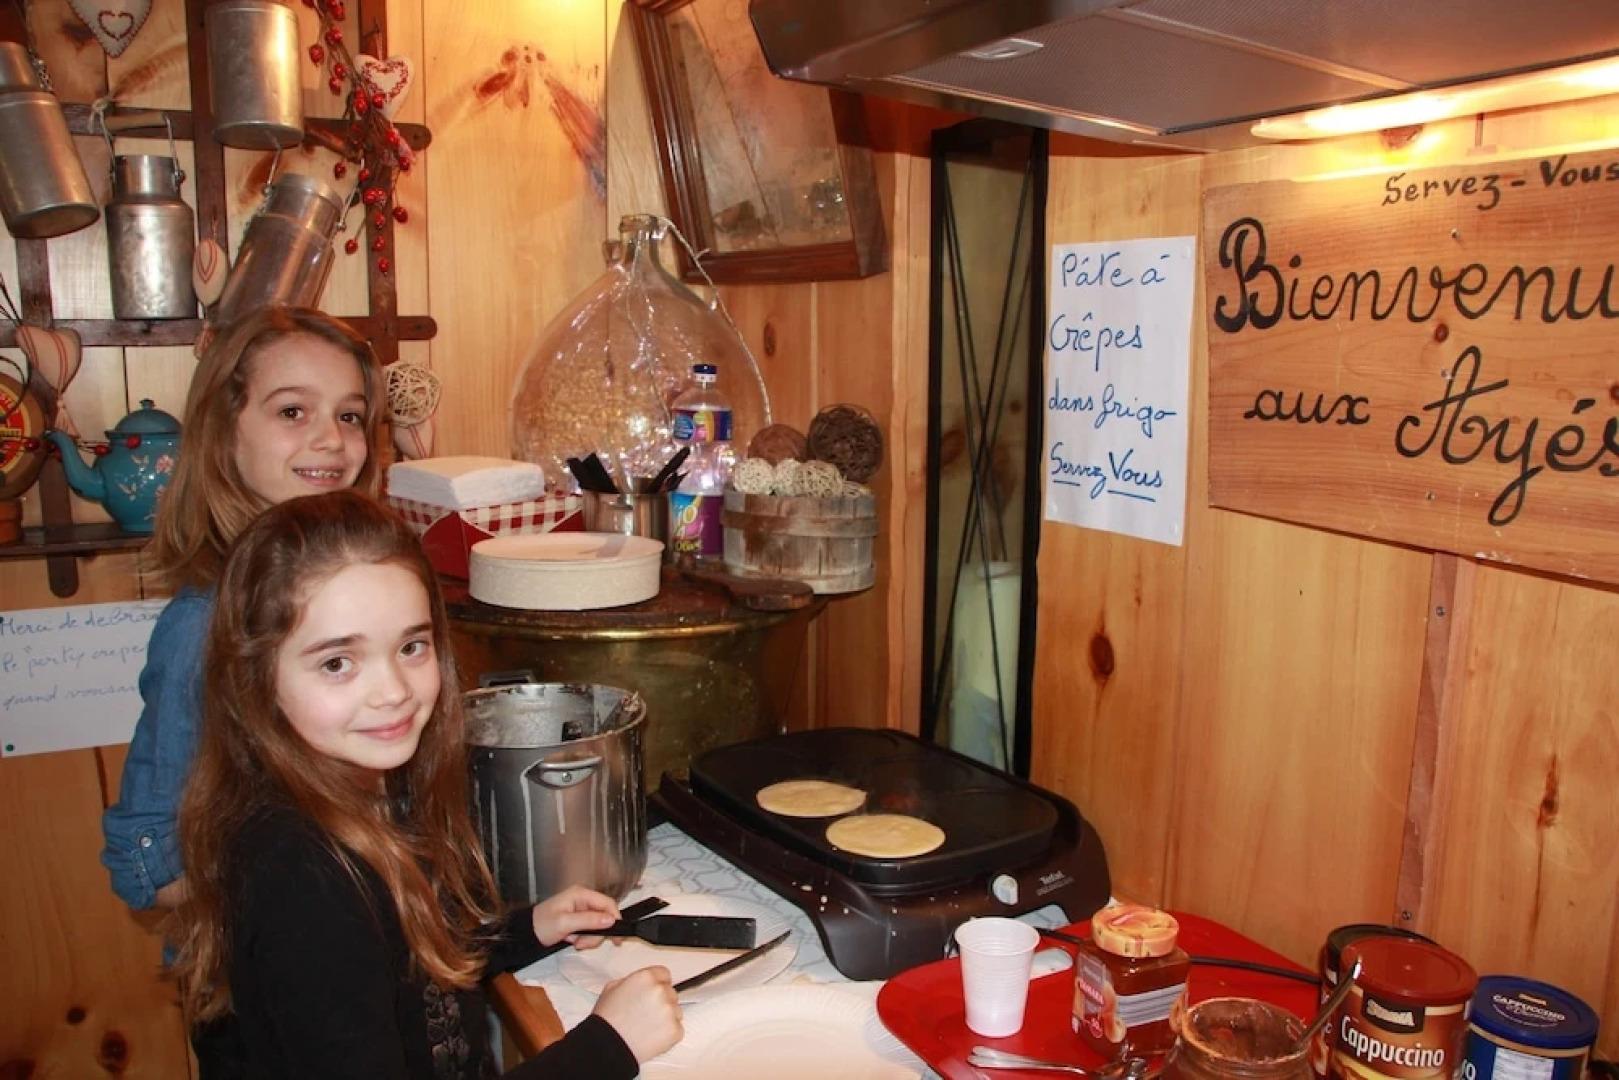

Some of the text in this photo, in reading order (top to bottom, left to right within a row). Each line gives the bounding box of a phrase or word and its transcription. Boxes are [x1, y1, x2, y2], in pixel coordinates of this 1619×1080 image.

[1049, 311, 1143, 373] Crêpes
[1048, 377, 1178, 438] dans frigo
[1243, 388, 1371, 426] aux
[1108, 448, 1163, 488] Vous
[1341, 1015, 1445, 1068] Cappuccino
